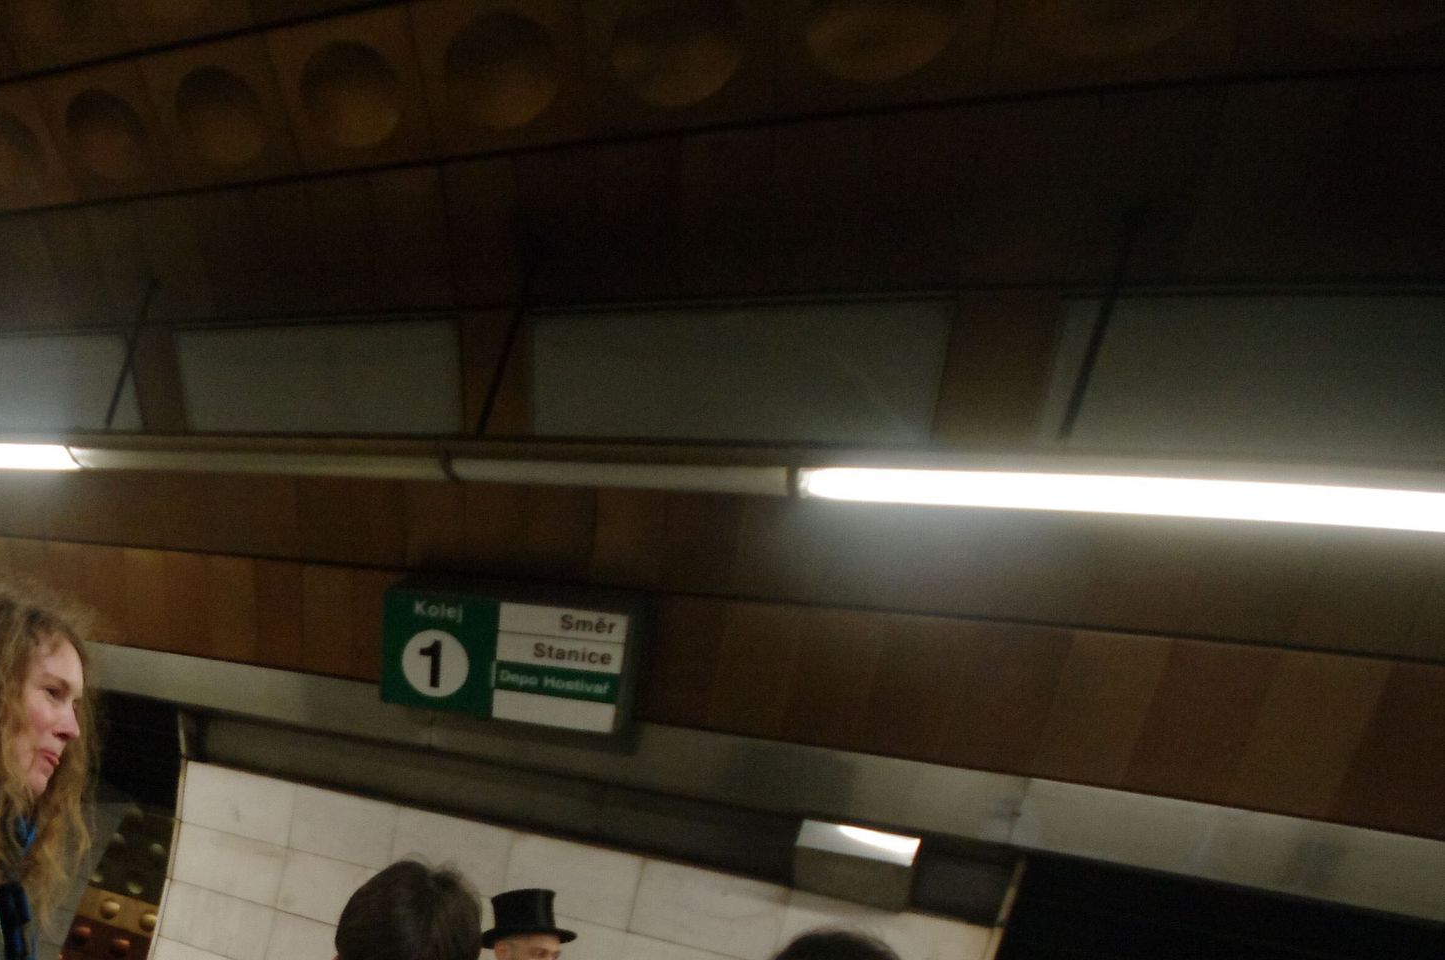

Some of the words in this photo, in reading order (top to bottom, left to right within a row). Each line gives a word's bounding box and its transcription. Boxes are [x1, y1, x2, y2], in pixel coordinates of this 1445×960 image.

[413, 601, 463, 623] Kolej
[560, 614, 616, 635] Směr
[419, 639, 443, 688] 1
[533, 642, 612, 666] Stanice
[500, 669, 538, 686] Depo
